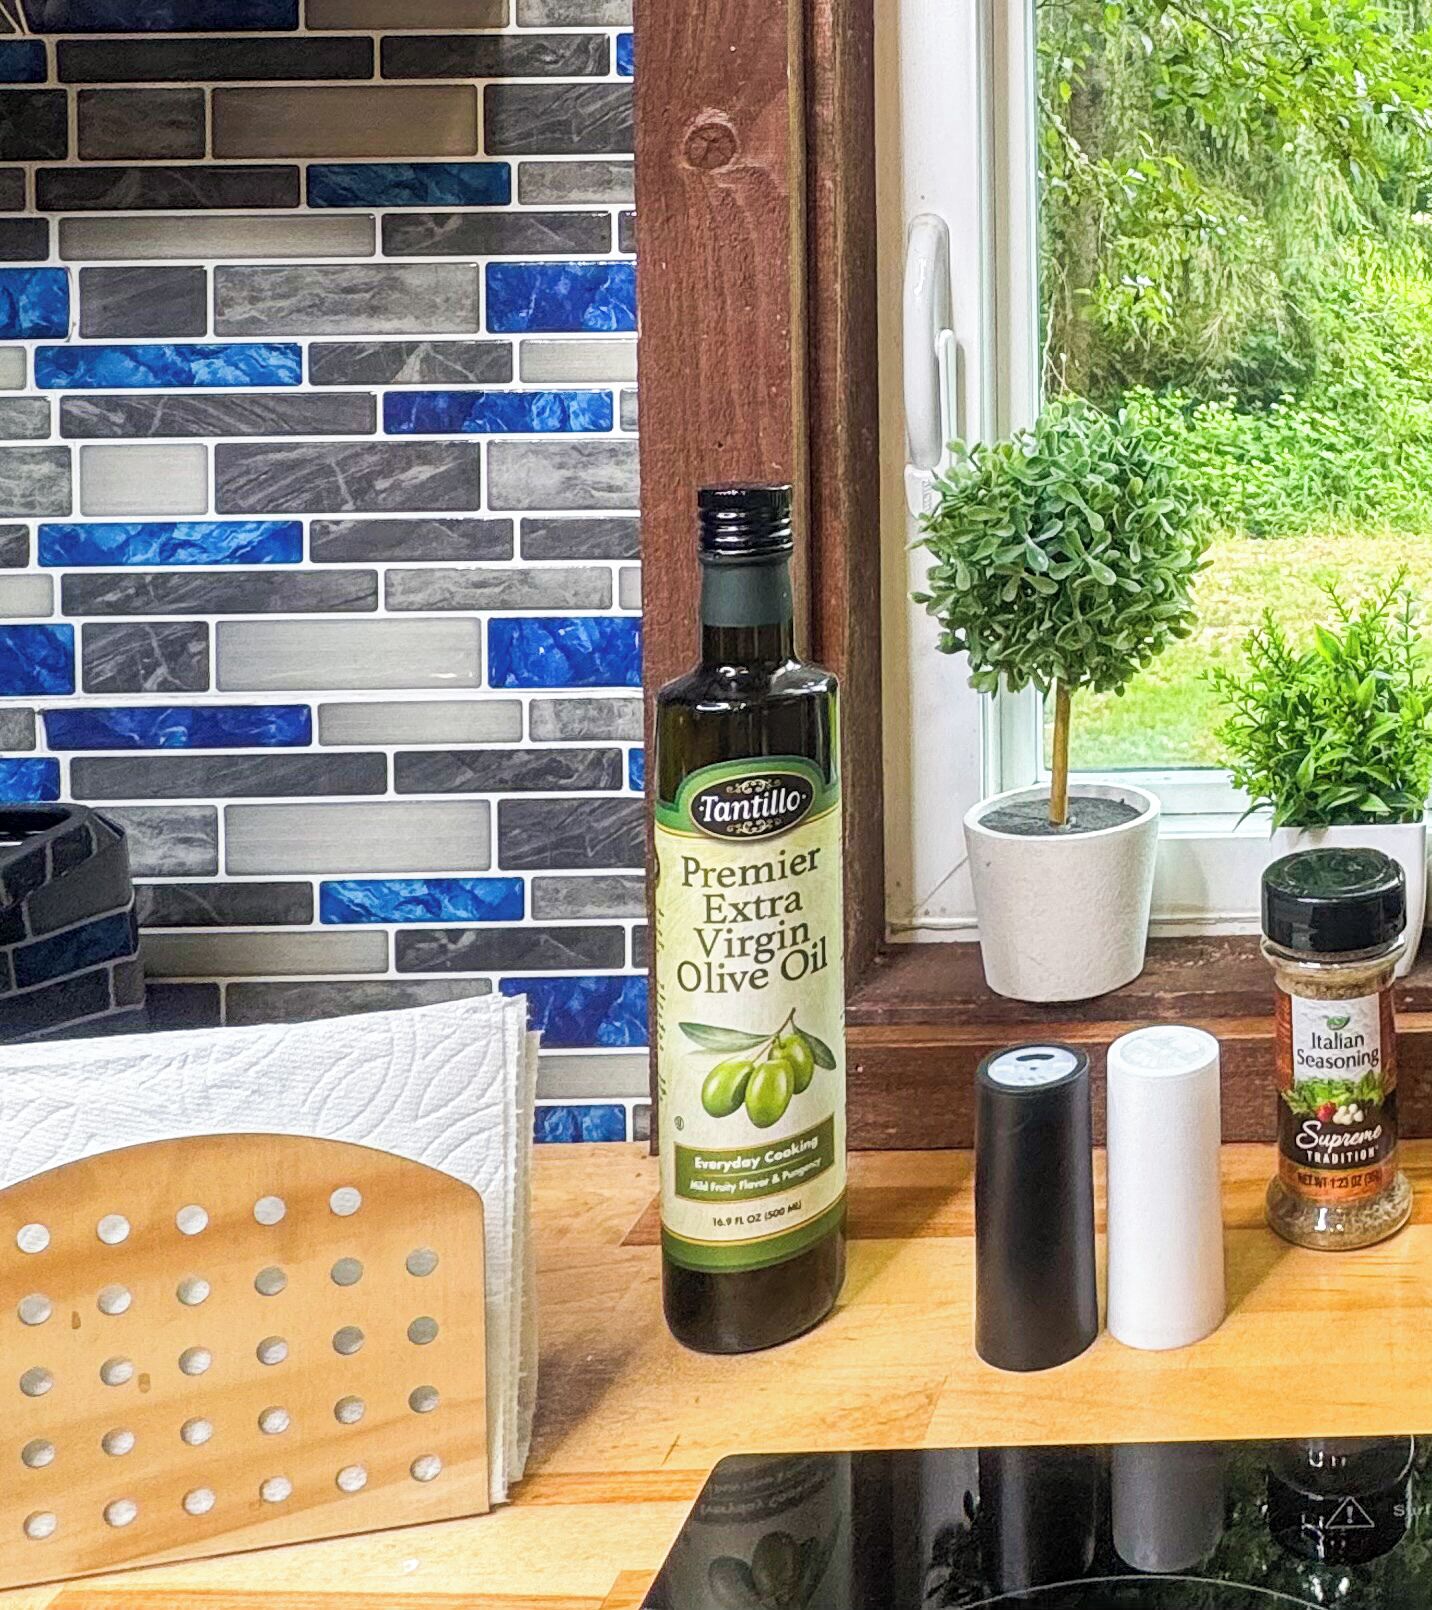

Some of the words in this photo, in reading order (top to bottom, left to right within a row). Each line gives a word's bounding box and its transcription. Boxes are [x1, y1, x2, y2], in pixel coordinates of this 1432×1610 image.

[701, 787, 801, 822] Tantillo
[681, 847, 821, 888] Premier
[702, 890, 803, 924] Extra
[693, 919, 810, 964] Virgin
[677, 960, 769, 993] Olive
[780, 935, 828, 981] Oil
[1311, 1031, 1365, 1050] Italian
[1296, 1047, 1380, 1070] Seasoning
[1295, 1120, 1383, 1154] Supreme
[694, 1156, 761, 1173] Everyday
[764, 1136, 818, 1163] Cooking
[1306, 1146, 1375, 1165] TRADITION
